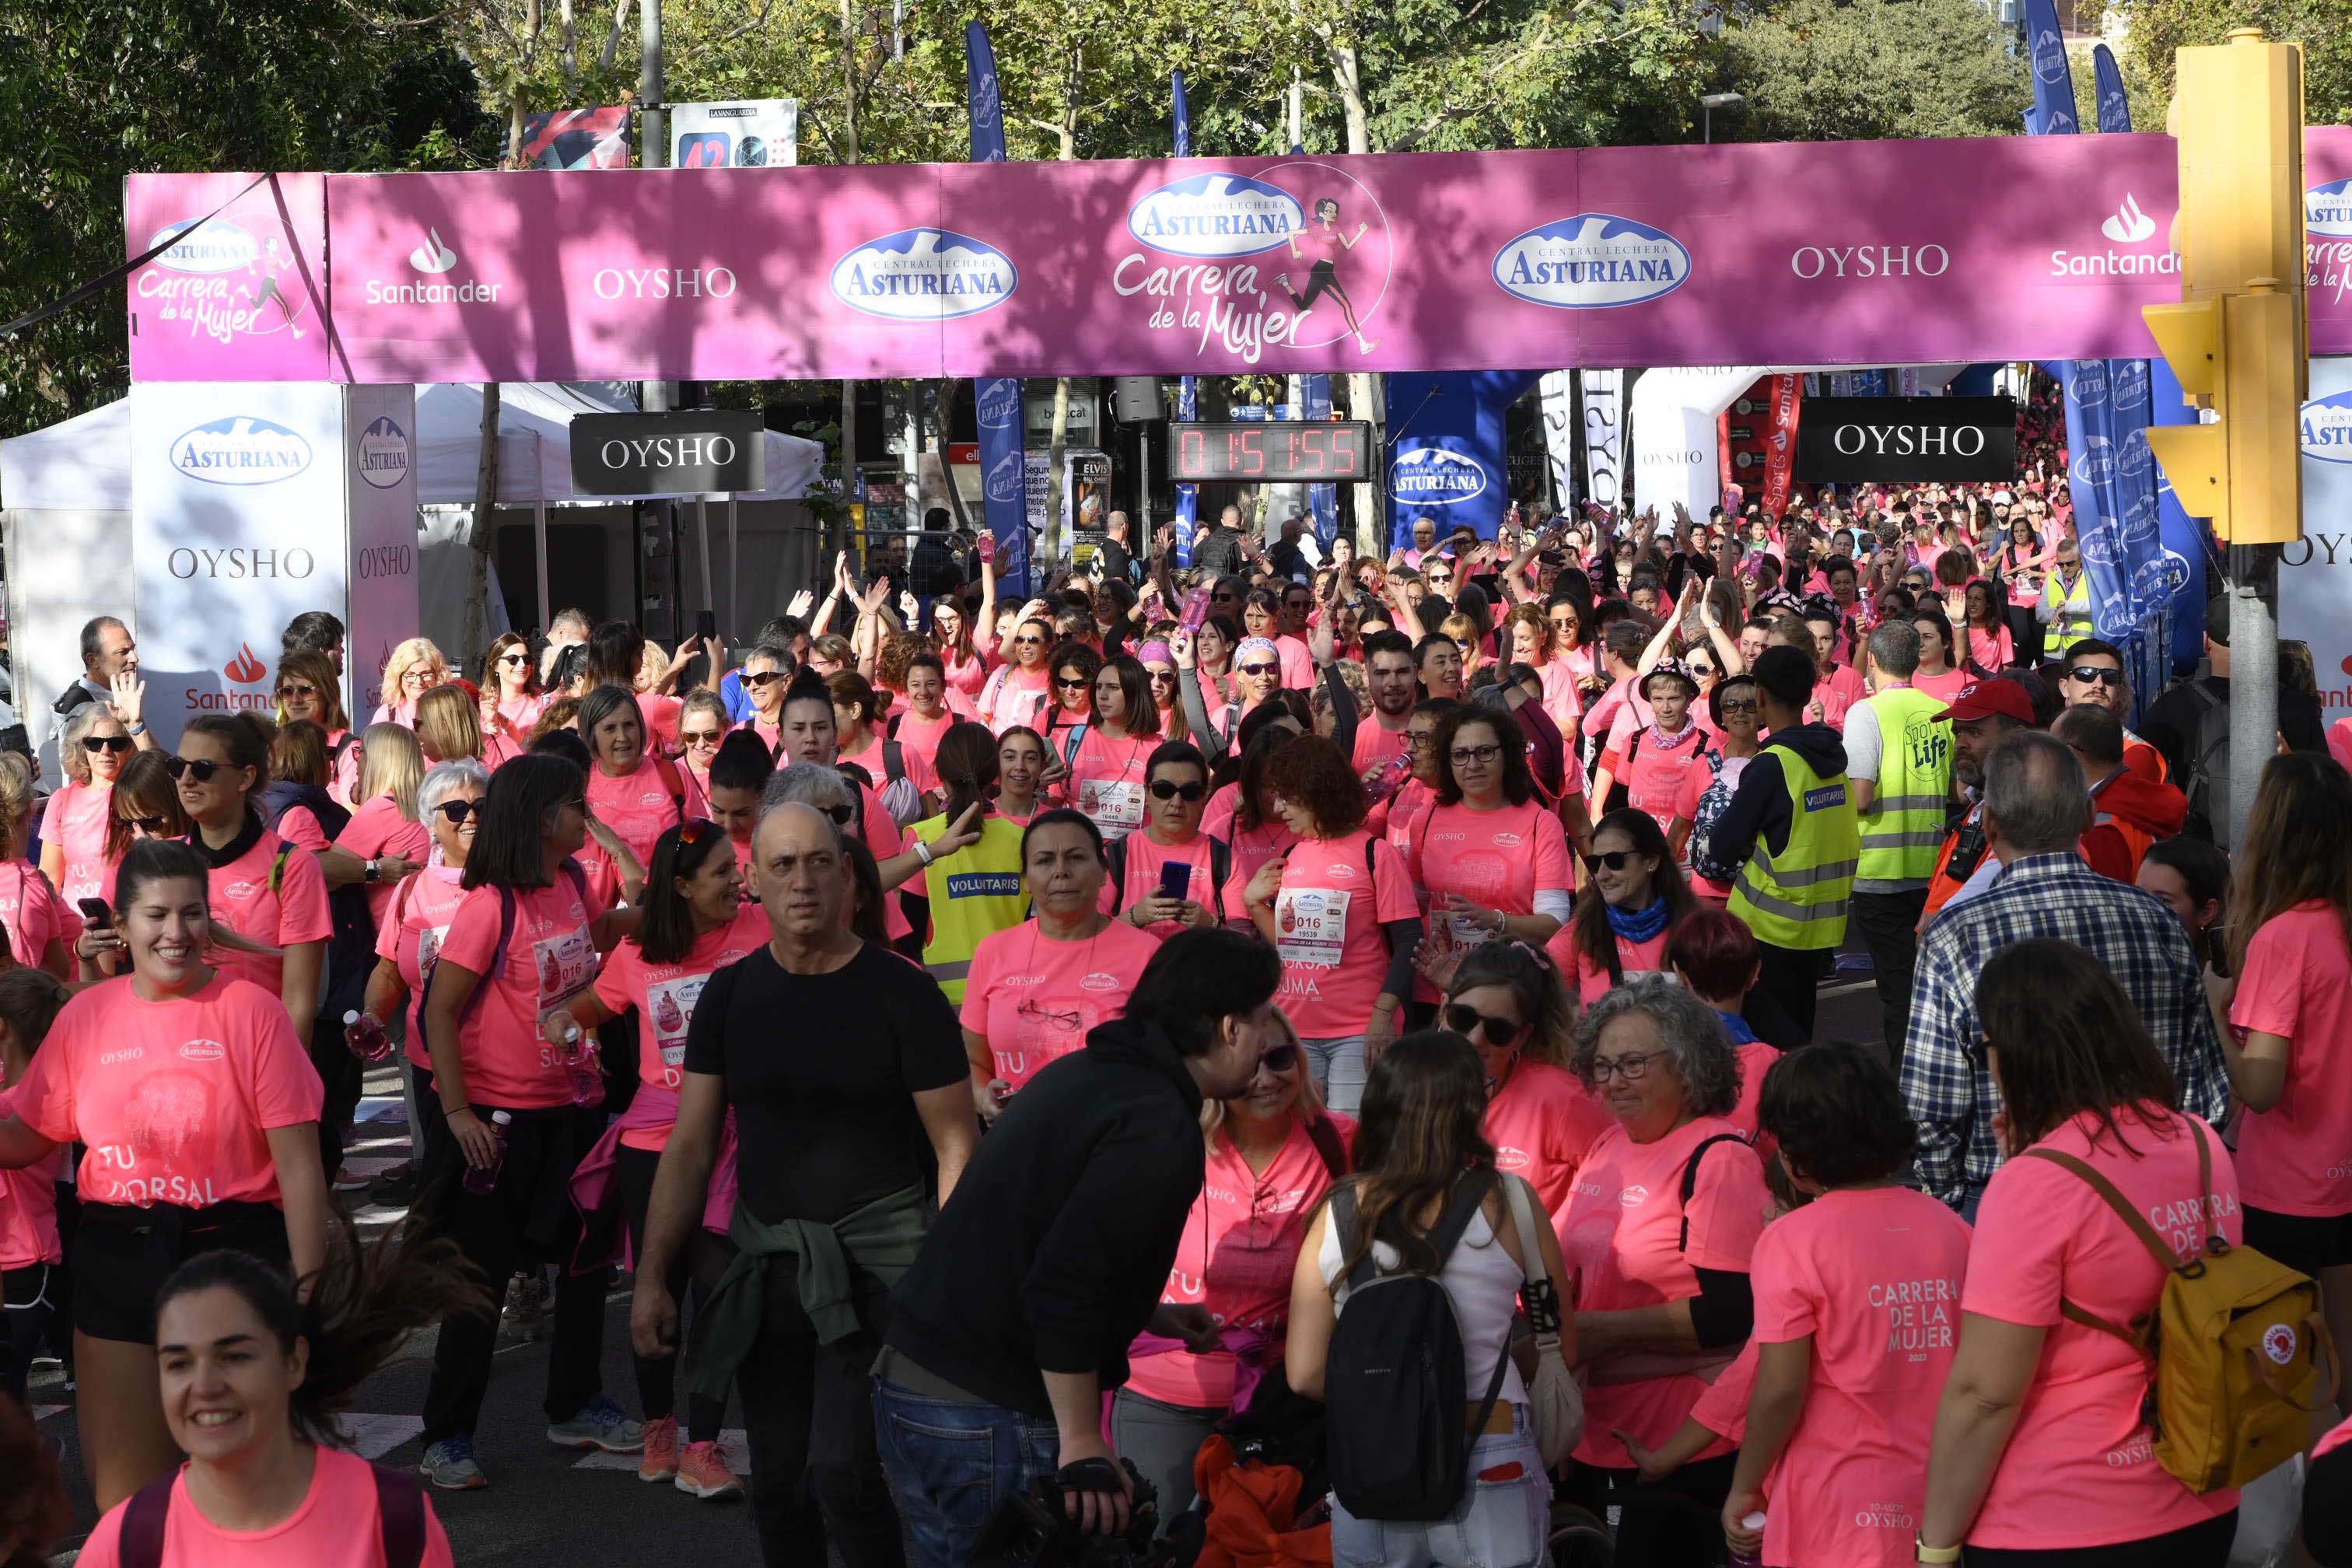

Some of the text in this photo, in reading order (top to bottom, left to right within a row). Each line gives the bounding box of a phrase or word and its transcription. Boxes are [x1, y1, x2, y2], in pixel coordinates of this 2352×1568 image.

[1230, 201, 1286, 210] LECHERA
[1143, 201, 1290, 236] ASTURIANA
[1538, 244, 1669, 257] CENTRAL LECHERA
[1791, 244, 1949, 278] OYSHO
[873, 260, 932, 270] CENTRAL
[1507, 250, 1675, 285] ASTURIANA
[2051, 250, 2182, 275] Santand
[137, 270, 228, 299] Carrera
[593, 268, 737, 299] OYSHO
[847, 263, 1004, 297] ASTURIANA
[1113, 253, 1258, 296] Carrera
[2323, 264, 2337, 286] la
[366, 280, 502, 304] Santander
[160, 299, 264, 344] de la Mujer
[1149, 296, 1312, 363] de la Mujer
[1834, 424, 1985, 456] OYSHO
[180, 442, 302, 467] ASTURIANA
[361, 447, 407, 471] ASTURIANA
[601, 436, 736, 468] OYSHO
[1083, 464, 1108, 474] ELVIS
[1766, 454, 1786, 507] Sports
[1391, 471, 1479, 492] ASTURIANA
[168, 548, 314, 579] OYSHO
[359, 544, 411, 579] OYSHO
[1906, 722, 1940, 745] Sport
[1913, 735, 1948, 768] Life
[1101, 803, 1122, 813] 016
[1629, 793, 1643, 808] TU
[1805, 789, 1846, 807] VOLUNTARIS
[1433, 832, 1465, 841] OYSHO
[71, 864, 86, 878] TU
[1130, 870, 1159, 879] OYSHO
[950, 877, 1020, 893] VOLUNTARIS
[426, 900, 460, 915] OYSHO
[1297, 899, 1323, 908] ASTURIANA
[1297, 917, 1321, 929] 016
[562, 962, 582, 980] 016
[644, 967, 684, 982] OYSHO
[1006, 975, 1046, 987] OYSHO
[1279, 975, 1320, 996] UMA
[101, 1047, 143, 1065] OYSHO
[183, 1047, 224, 1056] ASTURIANA
[996, 1051, 1025, 1074] TU
[98, 1144, 136, 1170] TU
[2151, 1190, 2239, 1233] CARRRA
[2172, 1225, 2201, 1255] DE
[1868, 1278, 1958, 1308] CARRERA
[1890, 1303, 1949, 1328] DE LA
[1887, 1325, 1953, 1353] MUJER
[1856, 1510, 1914, 1530] OYSHO
